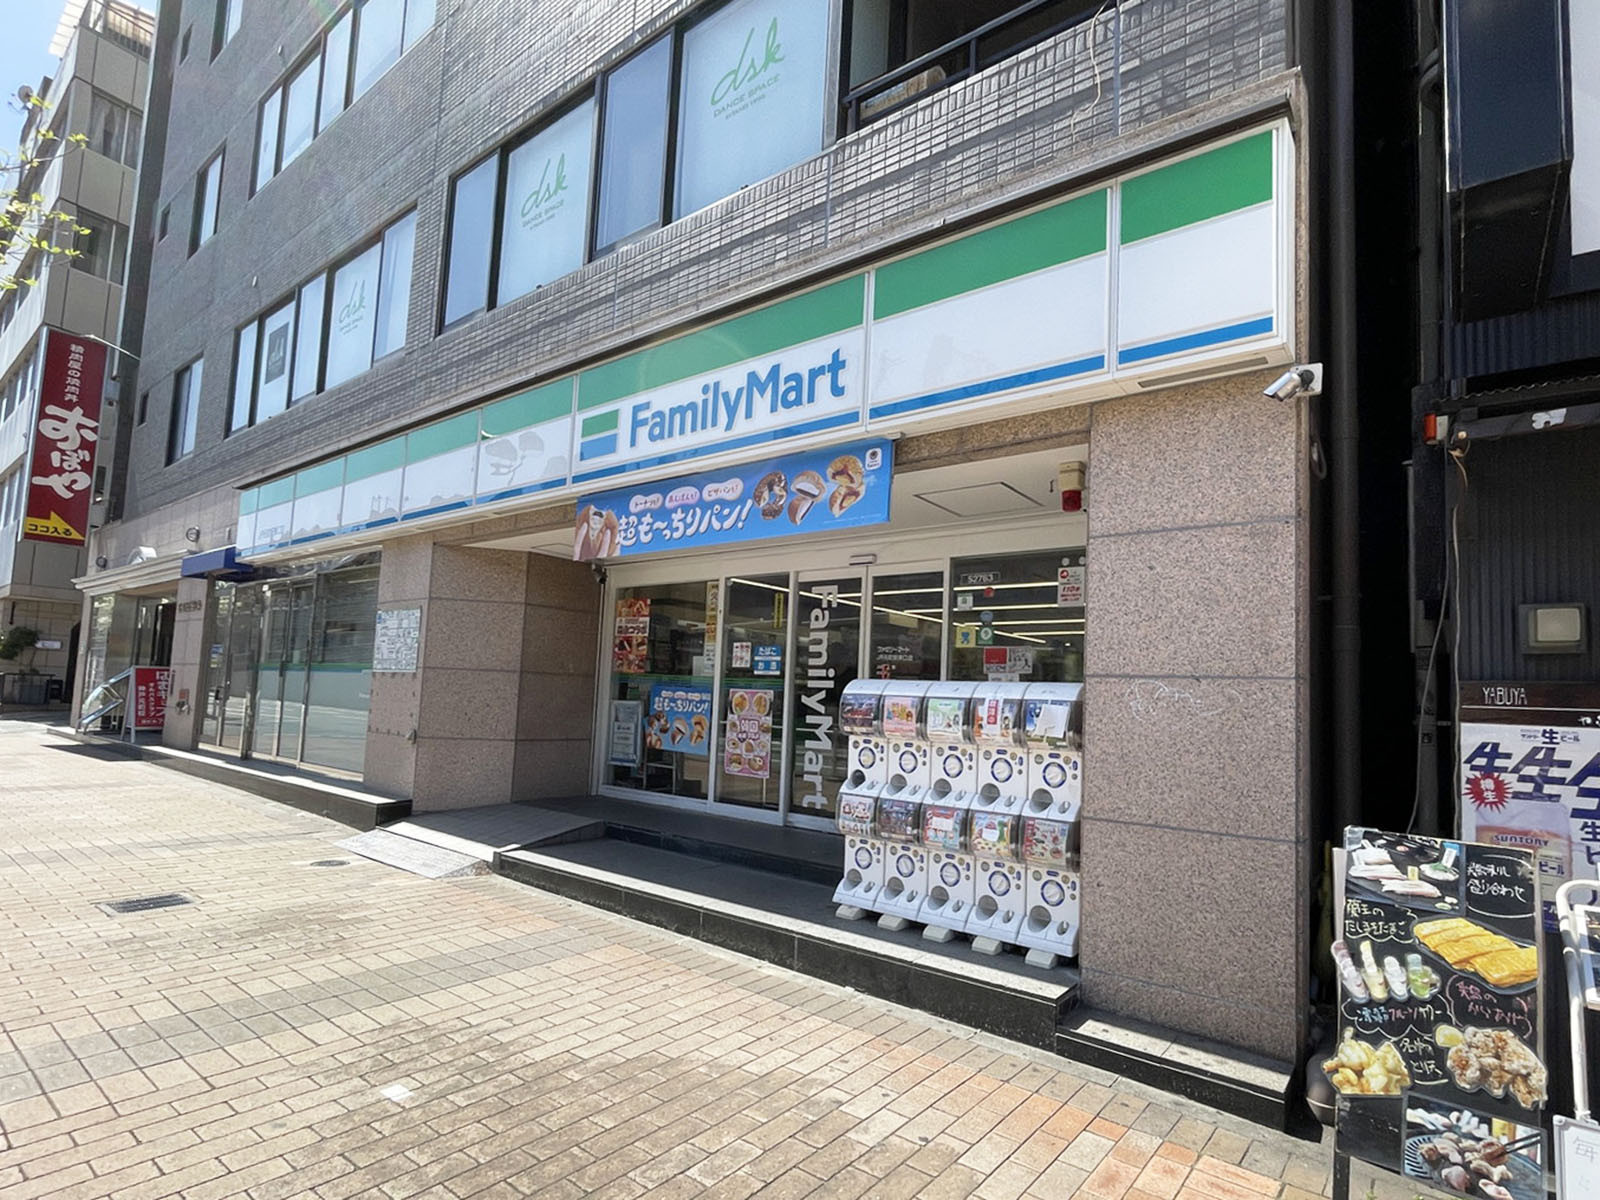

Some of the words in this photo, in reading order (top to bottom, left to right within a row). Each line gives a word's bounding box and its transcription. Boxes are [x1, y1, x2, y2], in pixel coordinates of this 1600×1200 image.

[710, 16, 786, 106] dsk
[713, 94, 746, 118] DANCE
[521, 152, 568, 218] dsk
[629, 348, 847, 448] FamilyMart
[27, 522, 73, 537] ココ入る
[801, 585, 839, 809] FamilyMart
[1482, 687, 1528, 705] YABUYA
[1539, 861, 1564, 875] ビール
